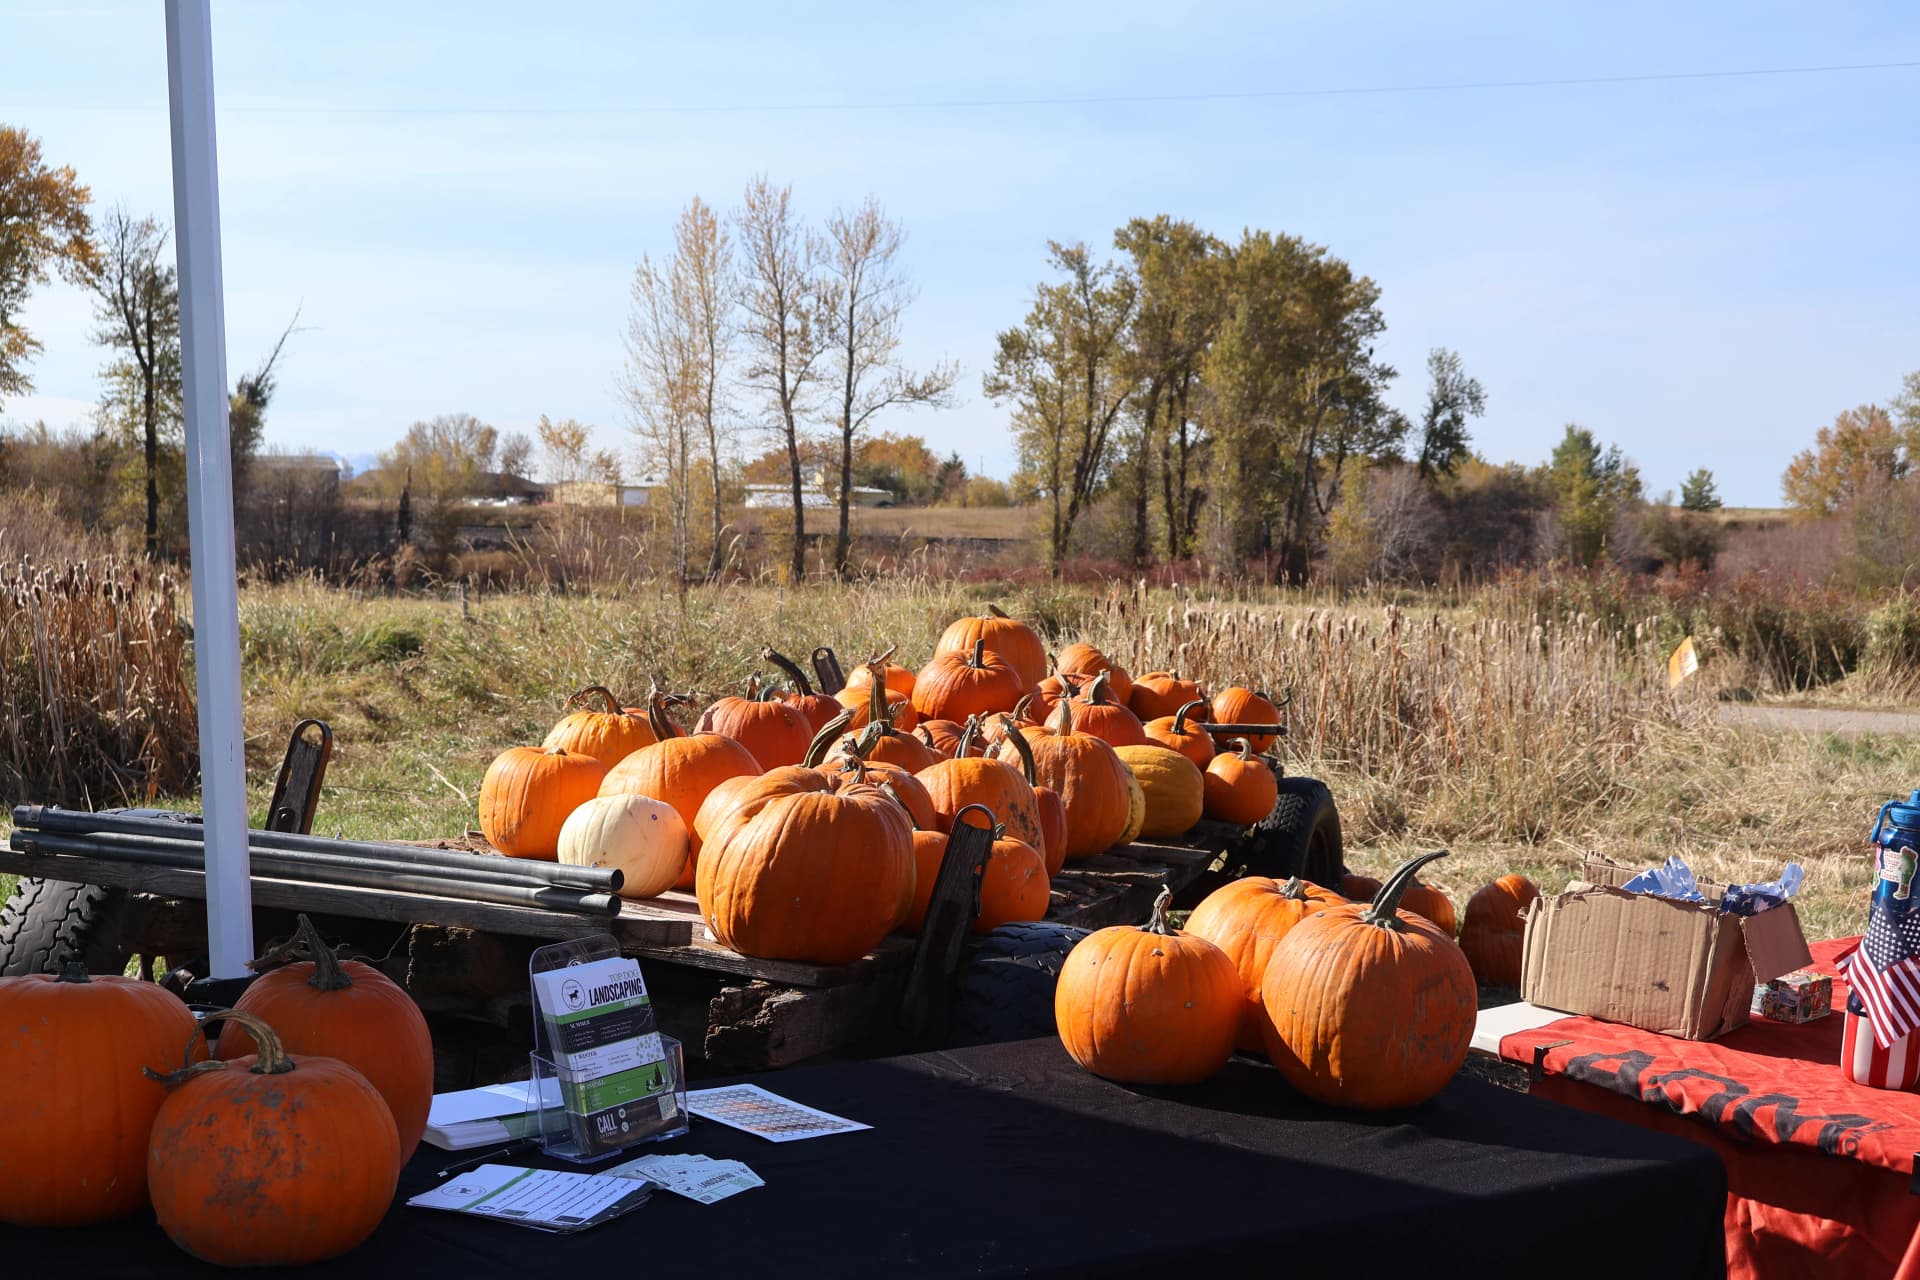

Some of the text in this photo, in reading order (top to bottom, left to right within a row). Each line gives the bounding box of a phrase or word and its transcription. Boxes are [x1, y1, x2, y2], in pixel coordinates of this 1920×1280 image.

[588, 977, 643, 1006] LANDSCAPING
[597, 1113, 618, 1134] CALL
[697, 1172, 736, 1189] LANDSCAPING
